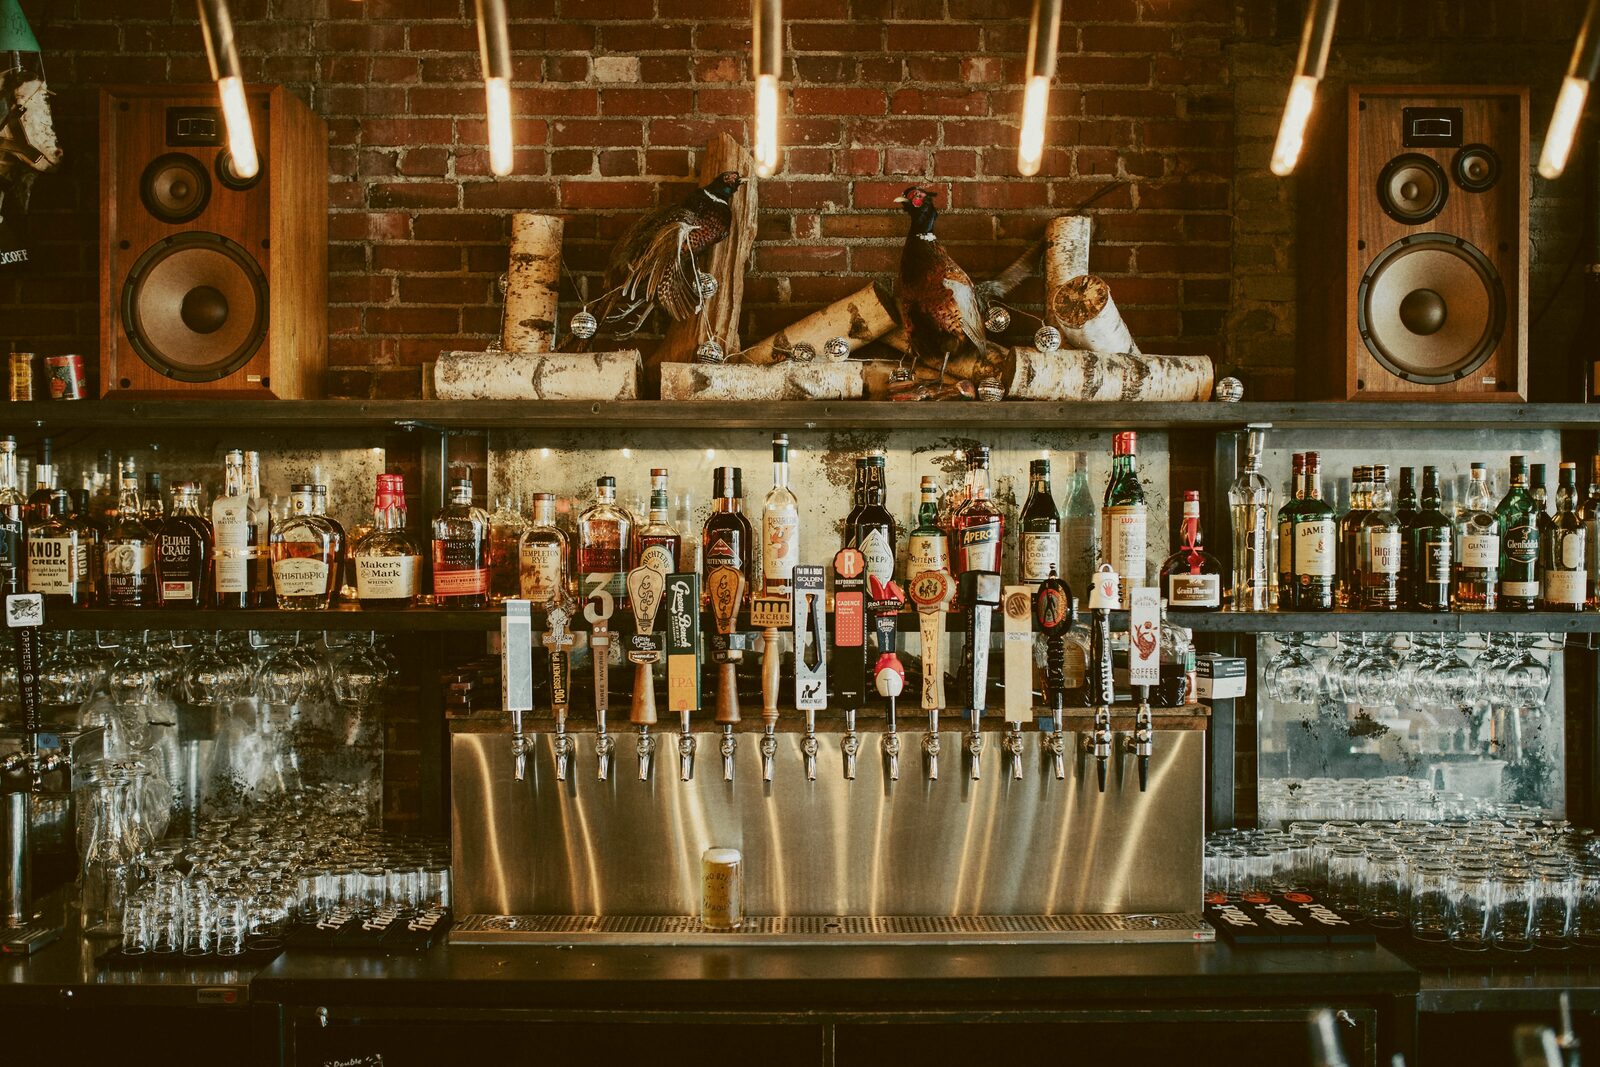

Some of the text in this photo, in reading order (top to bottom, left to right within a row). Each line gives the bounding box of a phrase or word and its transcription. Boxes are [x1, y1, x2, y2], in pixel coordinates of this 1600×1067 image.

[963, 530, 997, 545] APEROL
[1301, 526, 1336, 537] JAMEO
[162, 535, 190, 546] ELIJAH
[29, 542, 61, 558] KNOB
[161, 545, 191, 556] CRAIG
[77, 545, 87, 576] KNOB
[360, 560, 401, 569] Maker's
[844, 551, 855, 574] R
[371, 569, 401, 577] Mark
[583, 572, 614, 624] 3
[670, 581, 692, 648] Green Bench
[21, 630, 35, 730] ORPHEUS BREWING
[553, 662, 561, 690] BASEMENT
[671, 677, 694, 687] IPA
[554, 688, 565, 704] POG
